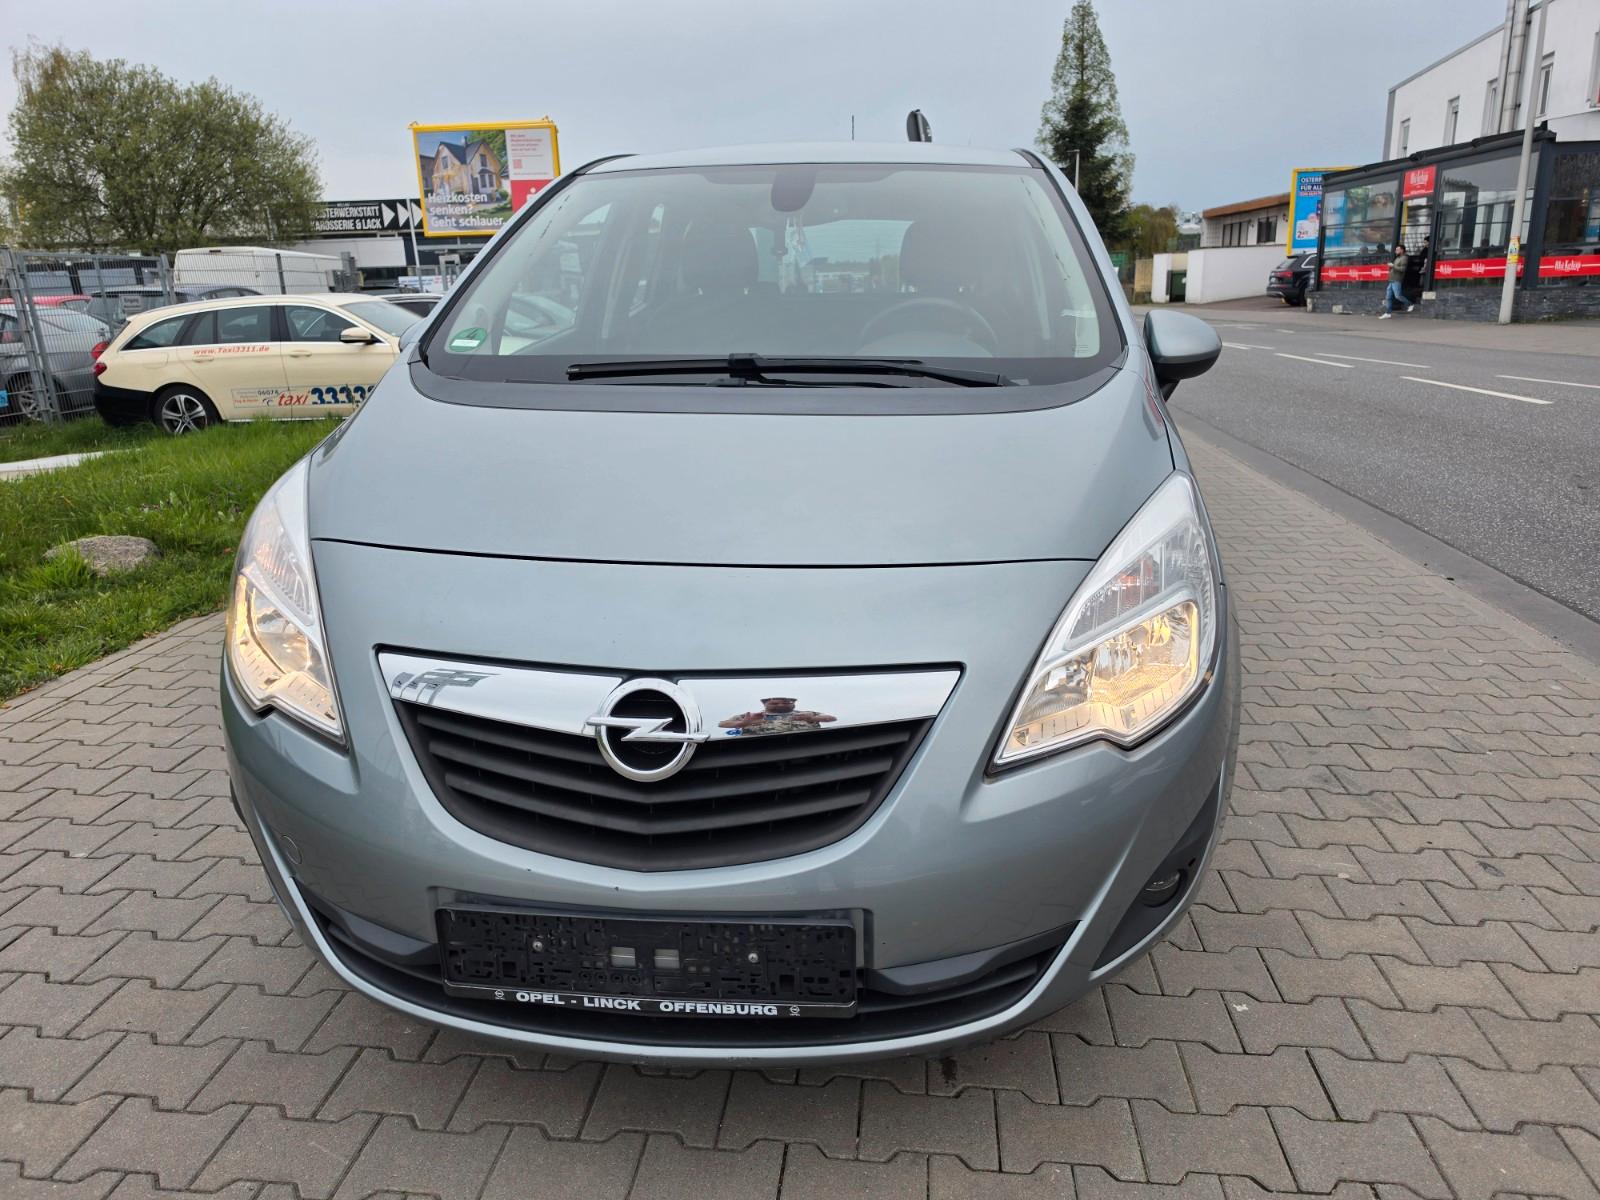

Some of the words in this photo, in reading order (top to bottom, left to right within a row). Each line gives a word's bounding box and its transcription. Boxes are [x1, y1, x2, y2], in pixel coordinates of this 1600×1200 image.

[1300, 183, 1312, 191] FÜR
[427, 192, 487, 204] Heizkosten
[309, 206, 380, 219] ISTERWERKSTATT
[430, 206, 473, 216] senken?
[355, 219, 361, 230] &
[362, 218, 382, 230] LACK
[431, 216, 456, 227] Geht
[459, 215, 507, 227] schlauer.
[278, 391, 309, 406] taxi
[311, 385, 376, 405] 3333
[516, 992, 565, 1005] OPEL
[583, 996, 641, 1010] LINCK
[659, 1001, 778, 1016] OFFENBURG
